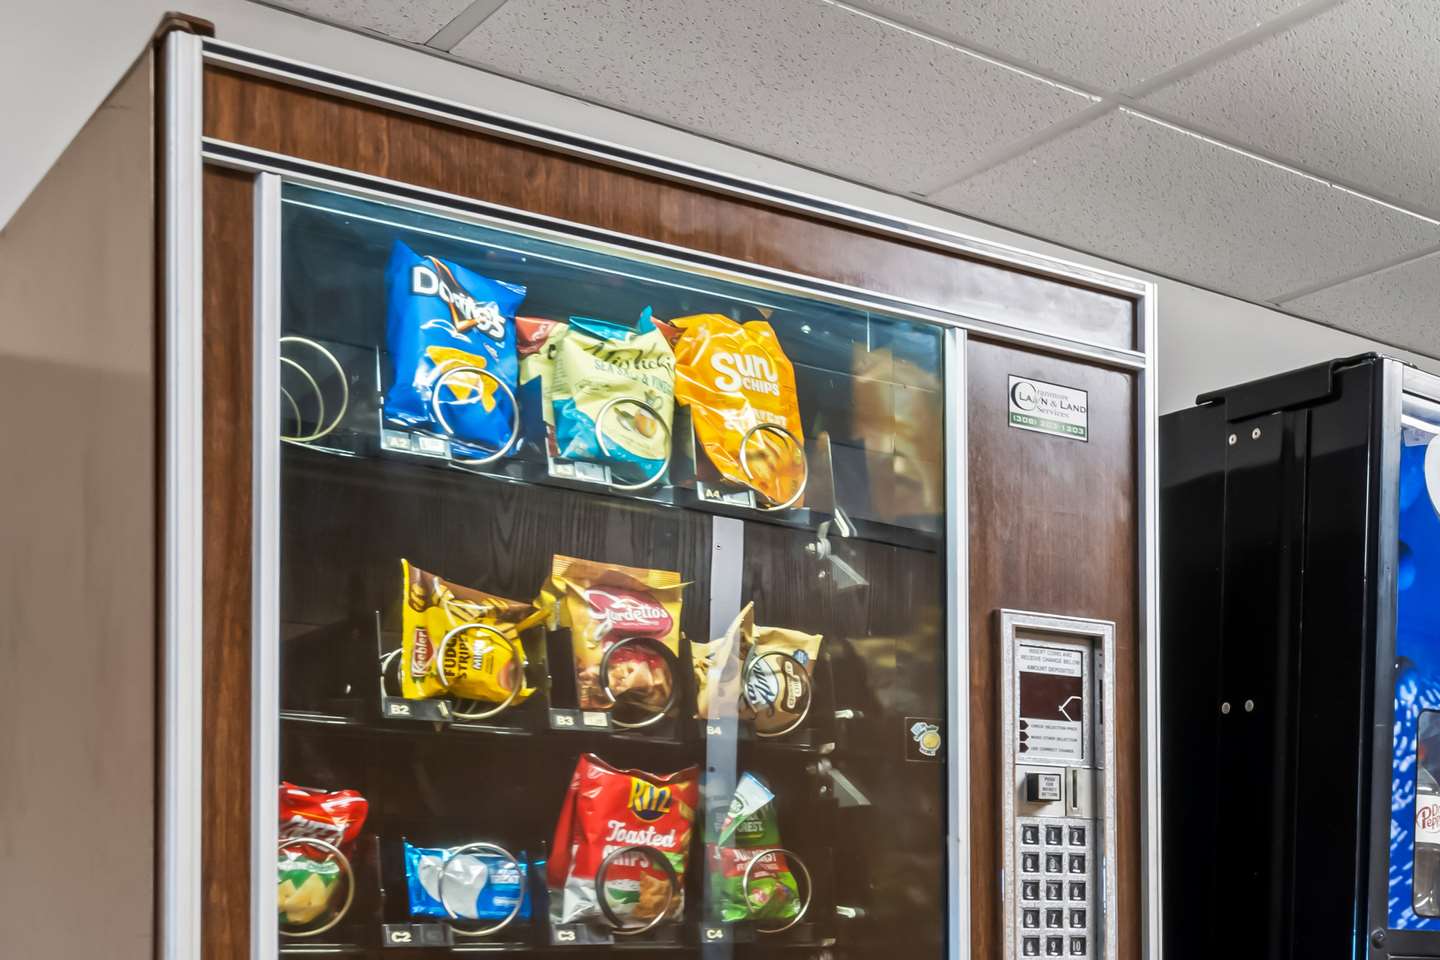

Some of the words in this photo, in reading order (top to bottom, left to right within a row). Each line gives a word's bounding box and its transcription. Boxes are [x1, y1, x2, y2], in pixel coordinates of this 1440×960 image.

[412, 265, 507, 339] Doritos
[711, 352, 779, 392] Sun
[742, 377, 780, 397] CHIPS
[1060, 400, 1088, 413] LAND
[391, 705, 411, 715] B2
[556, 716, 575, 726] B3
[707, 726, 722, 735] B4
[628, 776, 673, 813] RITZ
[605, 820, 677, 847] Toasted
[391, 931, 412, 943] C2
[557, 930, 576, 941] C3
[706, 929, 723, 939] C4
